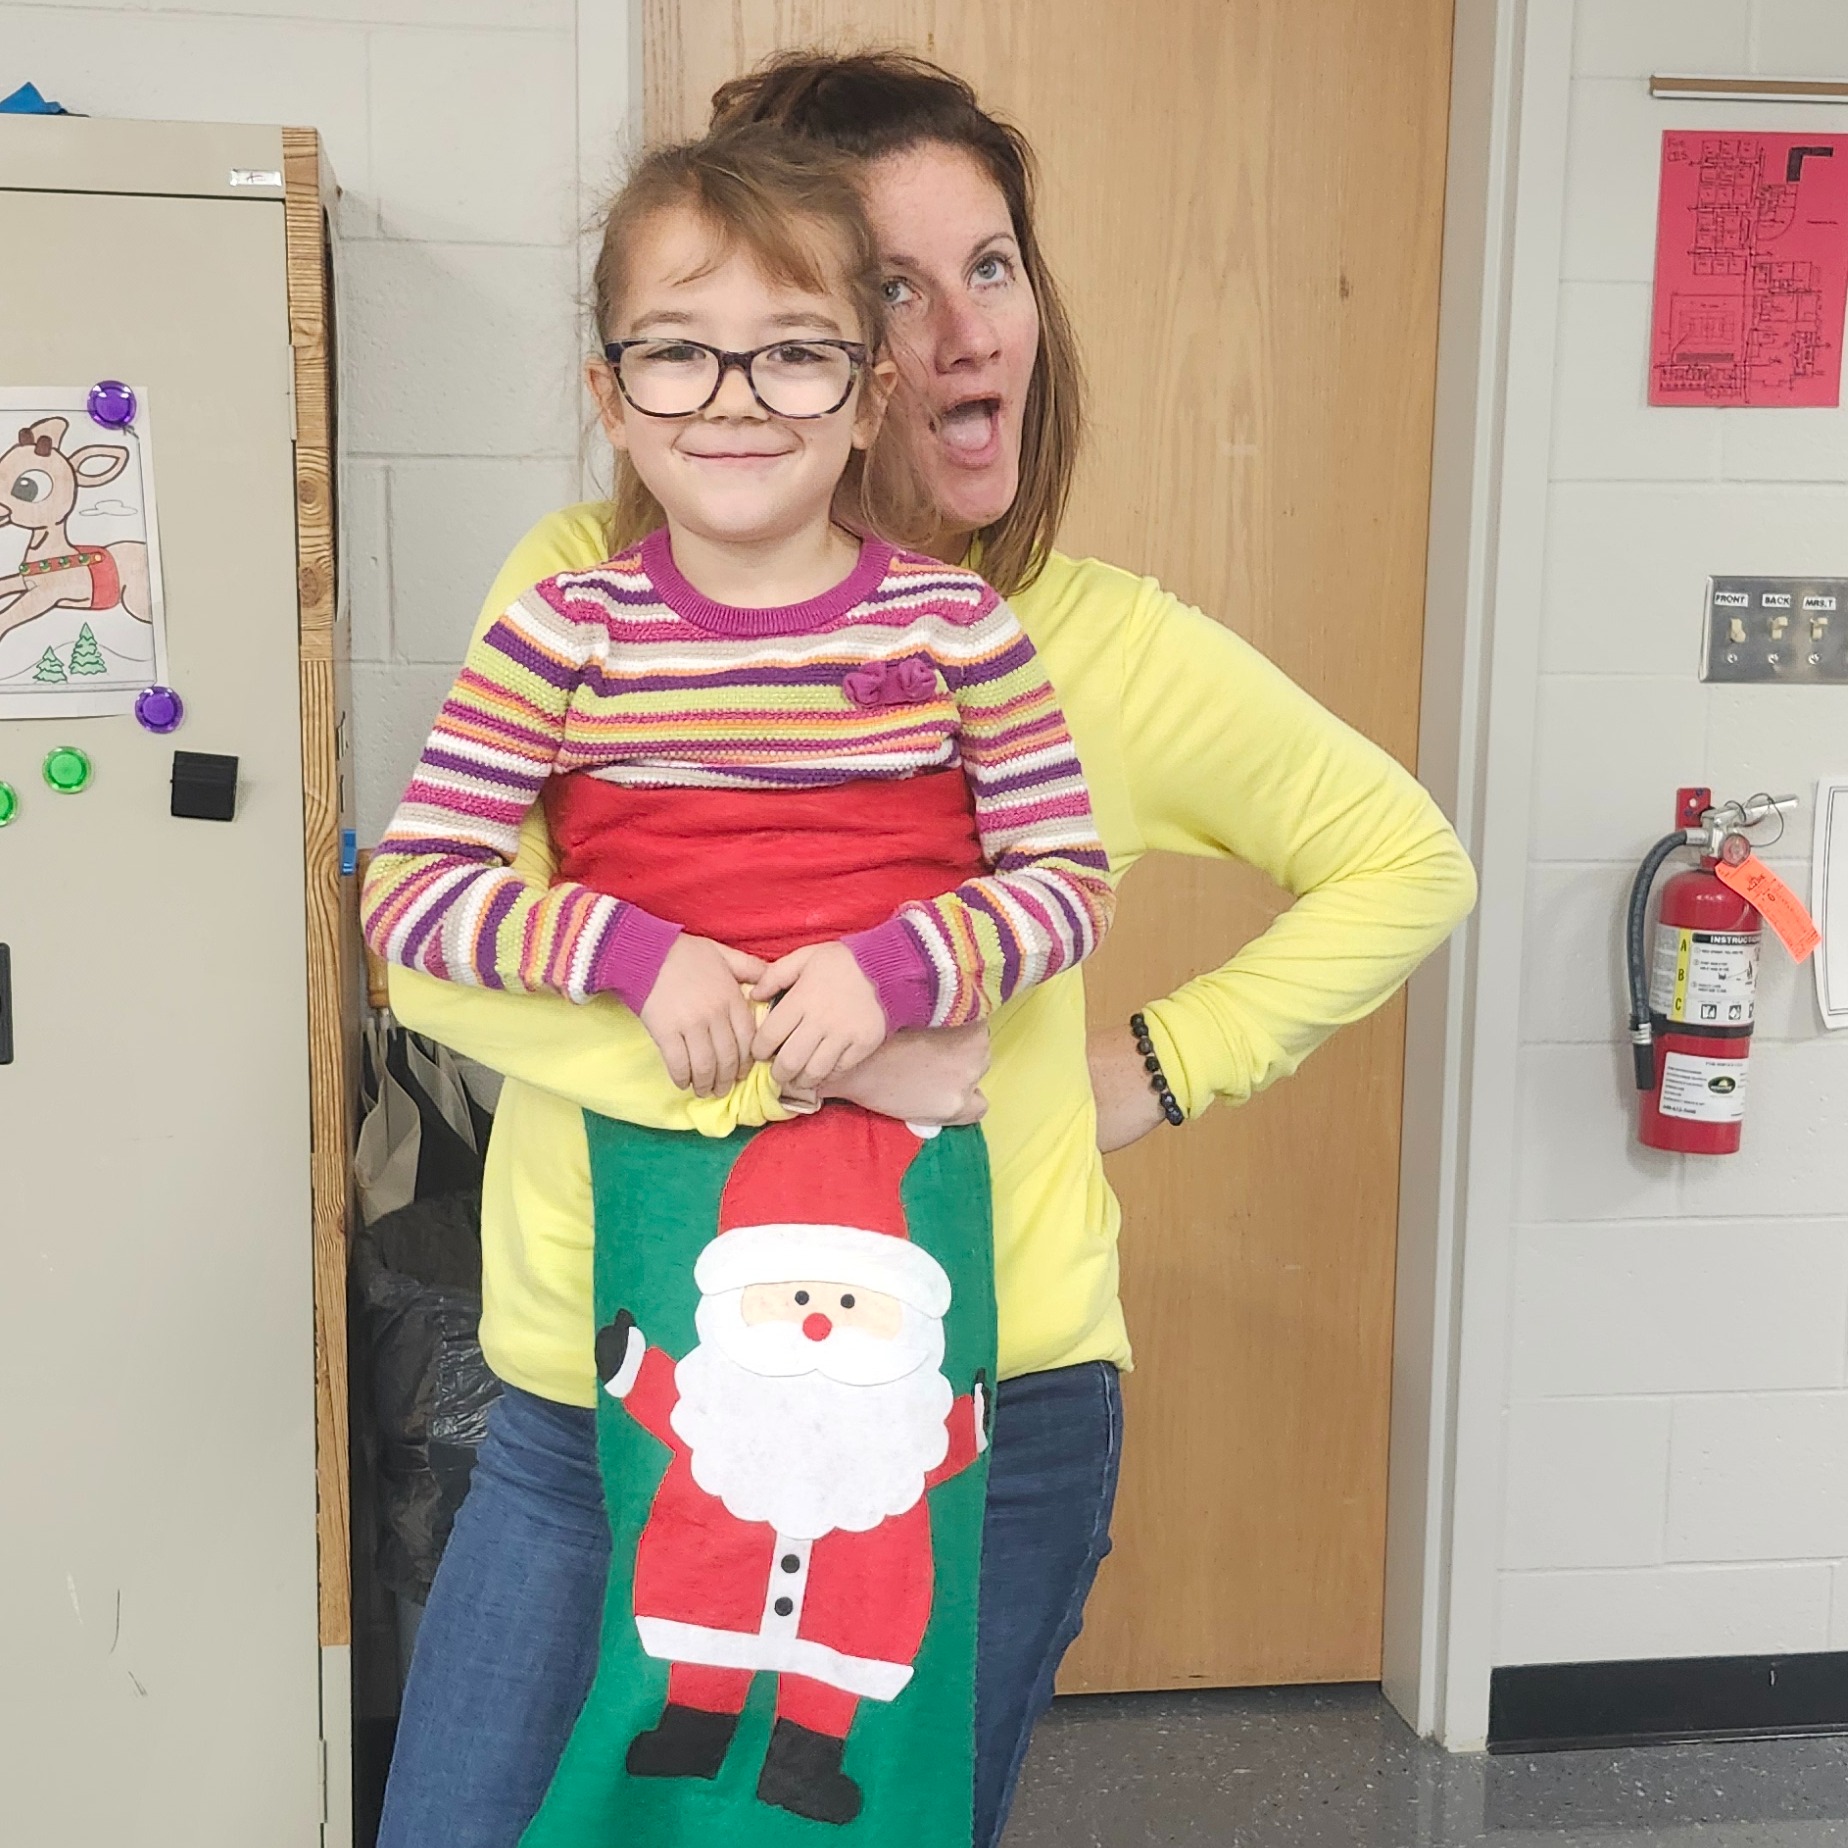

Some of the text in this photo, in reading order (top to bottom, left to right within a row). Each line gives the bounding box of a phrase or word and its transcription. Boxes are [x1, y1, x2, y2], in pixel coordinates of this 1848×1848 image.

[1716, 594, 1746, 604] FRONT
[1765, 596, 1790, 605] BACK
[1680, 939, 1687, 952] A
[1678, 969, 1685, 981] B
[1675, 998, 1682, 1011] C
